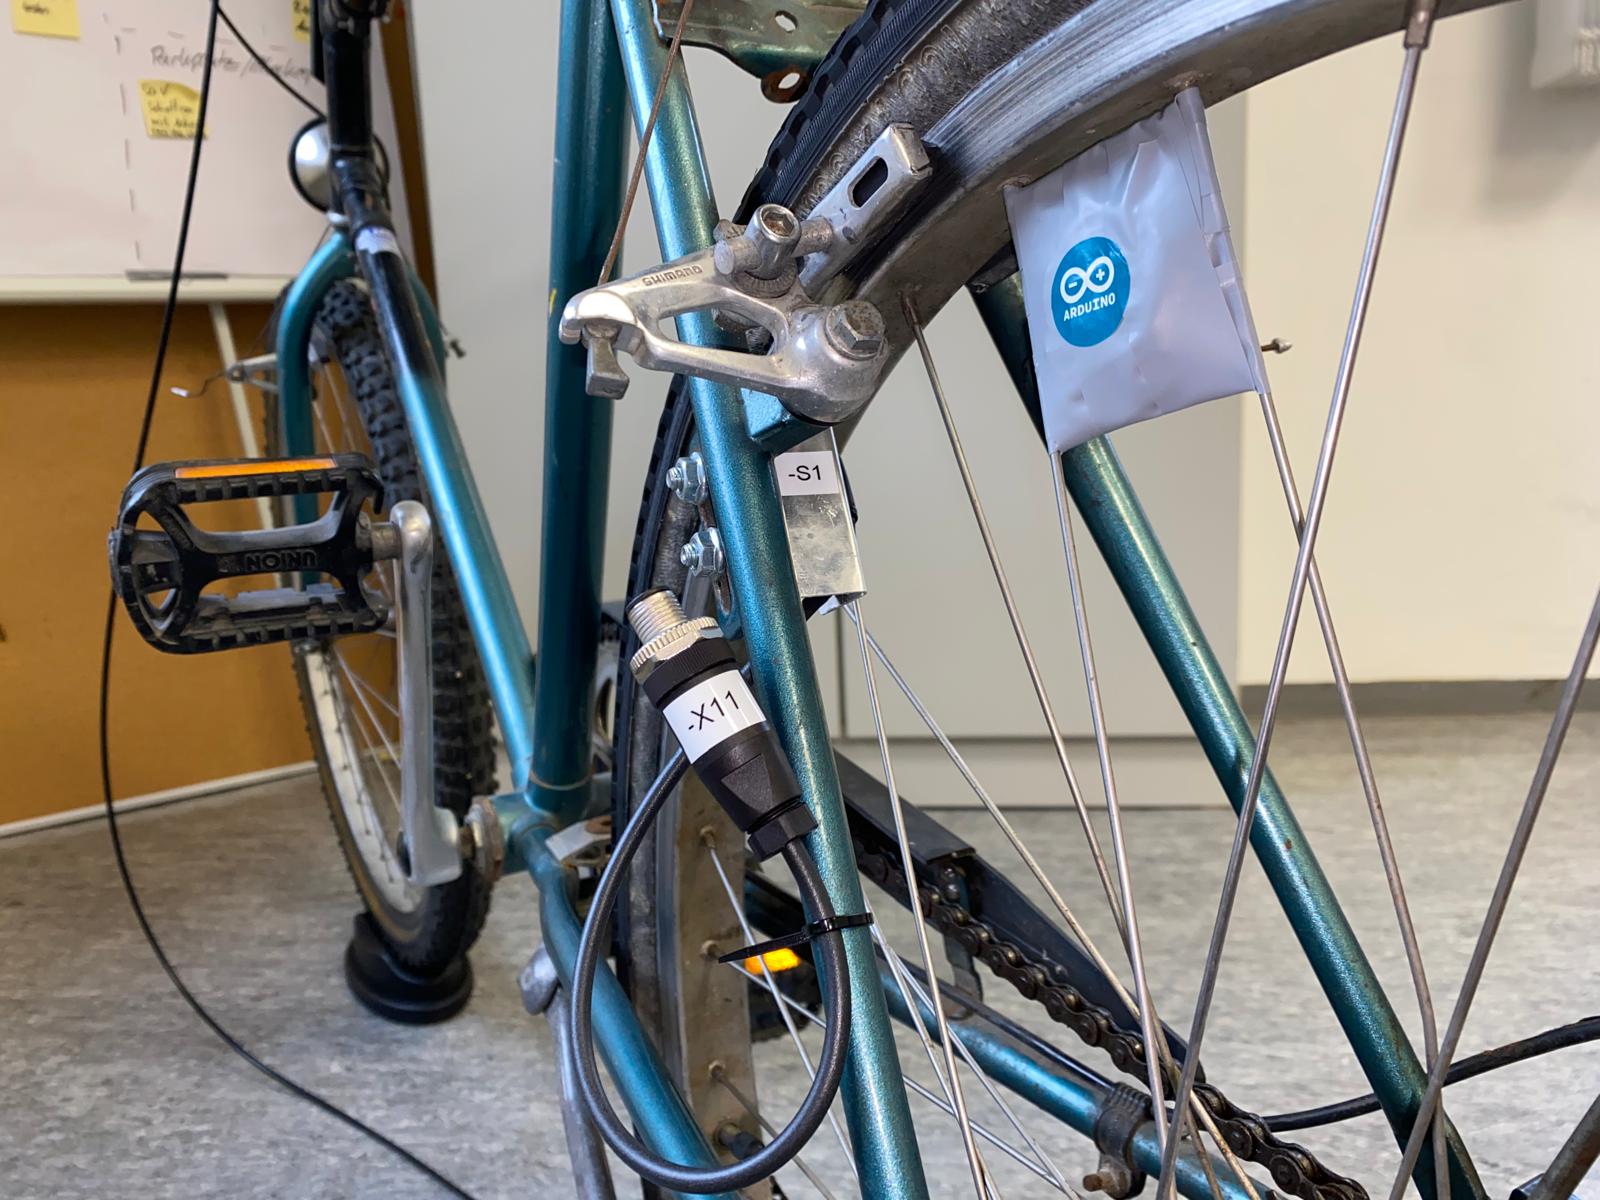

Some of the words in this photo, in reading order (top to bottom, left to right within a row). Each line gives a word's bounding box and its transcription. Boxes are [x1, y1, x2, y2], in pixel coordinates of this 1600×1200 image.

[642, 265, 703, 286] SHIMANO
[1063, 292, 1116, 322] ARDUINO
[788, 465, 822, 481] -S1
[244, 549, 317, 570] UNION
[688, 691, 740, 731] -X11
